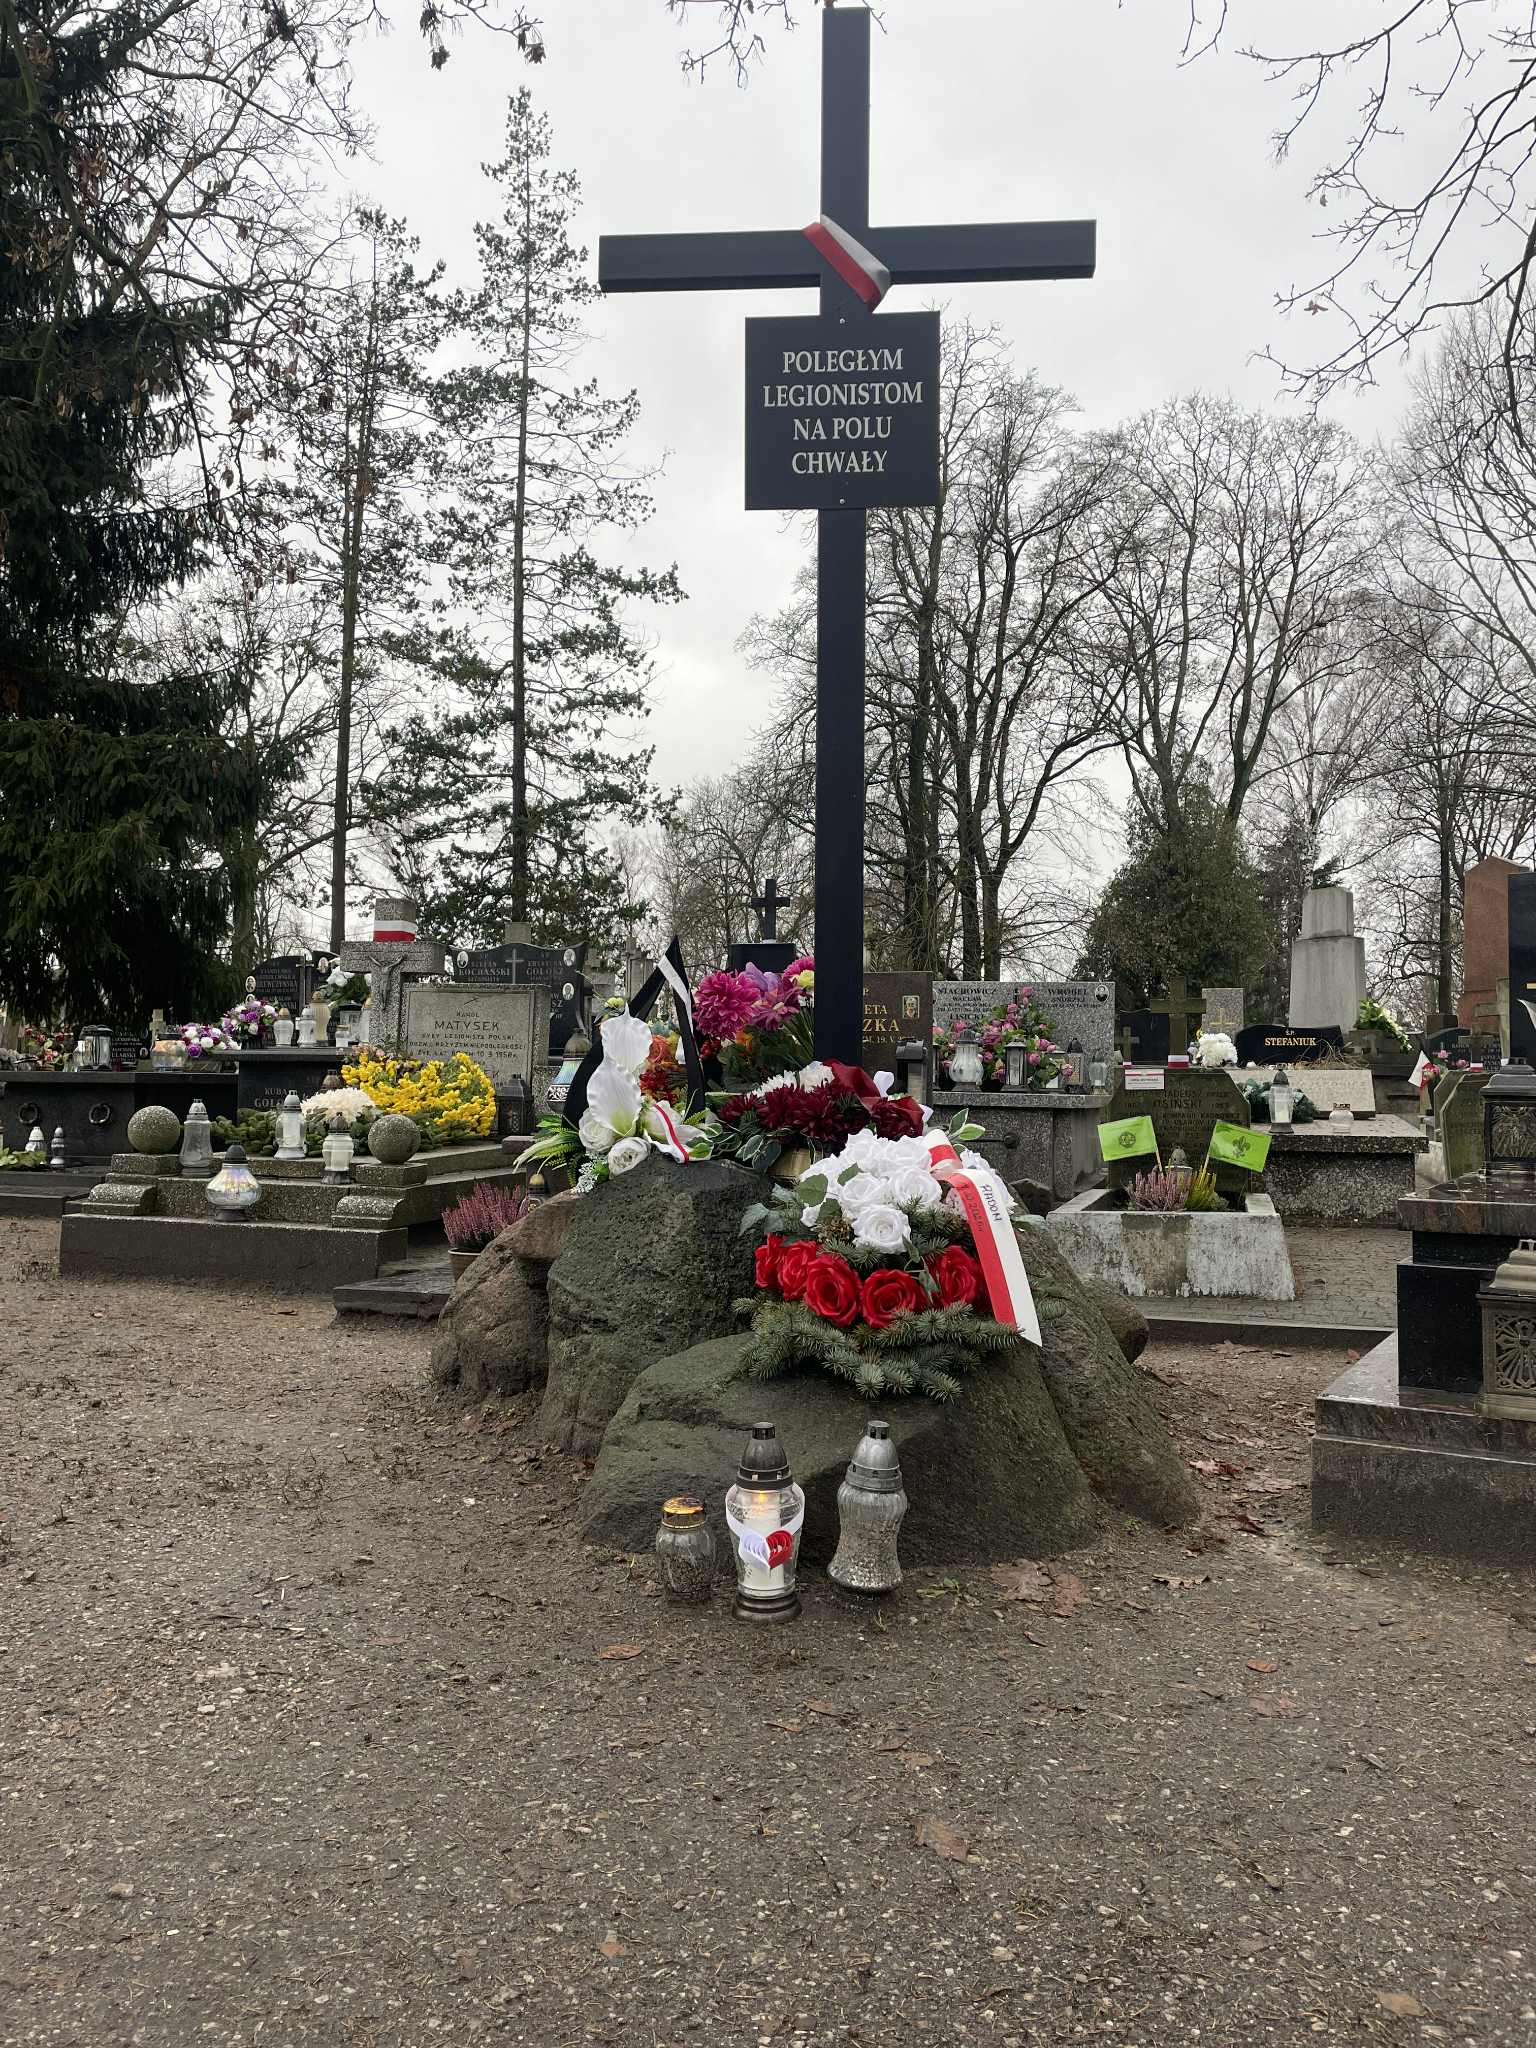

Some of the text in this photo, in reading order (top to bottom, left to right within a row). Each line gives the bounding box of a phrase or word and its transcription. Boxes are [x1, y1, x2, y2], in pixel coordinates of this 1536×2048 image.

[782, 348, 904, 374] POLEGŁYM
[762, 381, 923, 407] LEGIONISTOM
[793, 415, 893, 440] NA POLU
[791, 449, 888, 474] CHWAŁY
[863, 1004, 888, 1015] ETA
[434, 1020, 500, 1032] MATYSEK
[863, 1018, 900, 1032] ZKA
[1264, 1037, 1318, 1046] STEFANIUK
